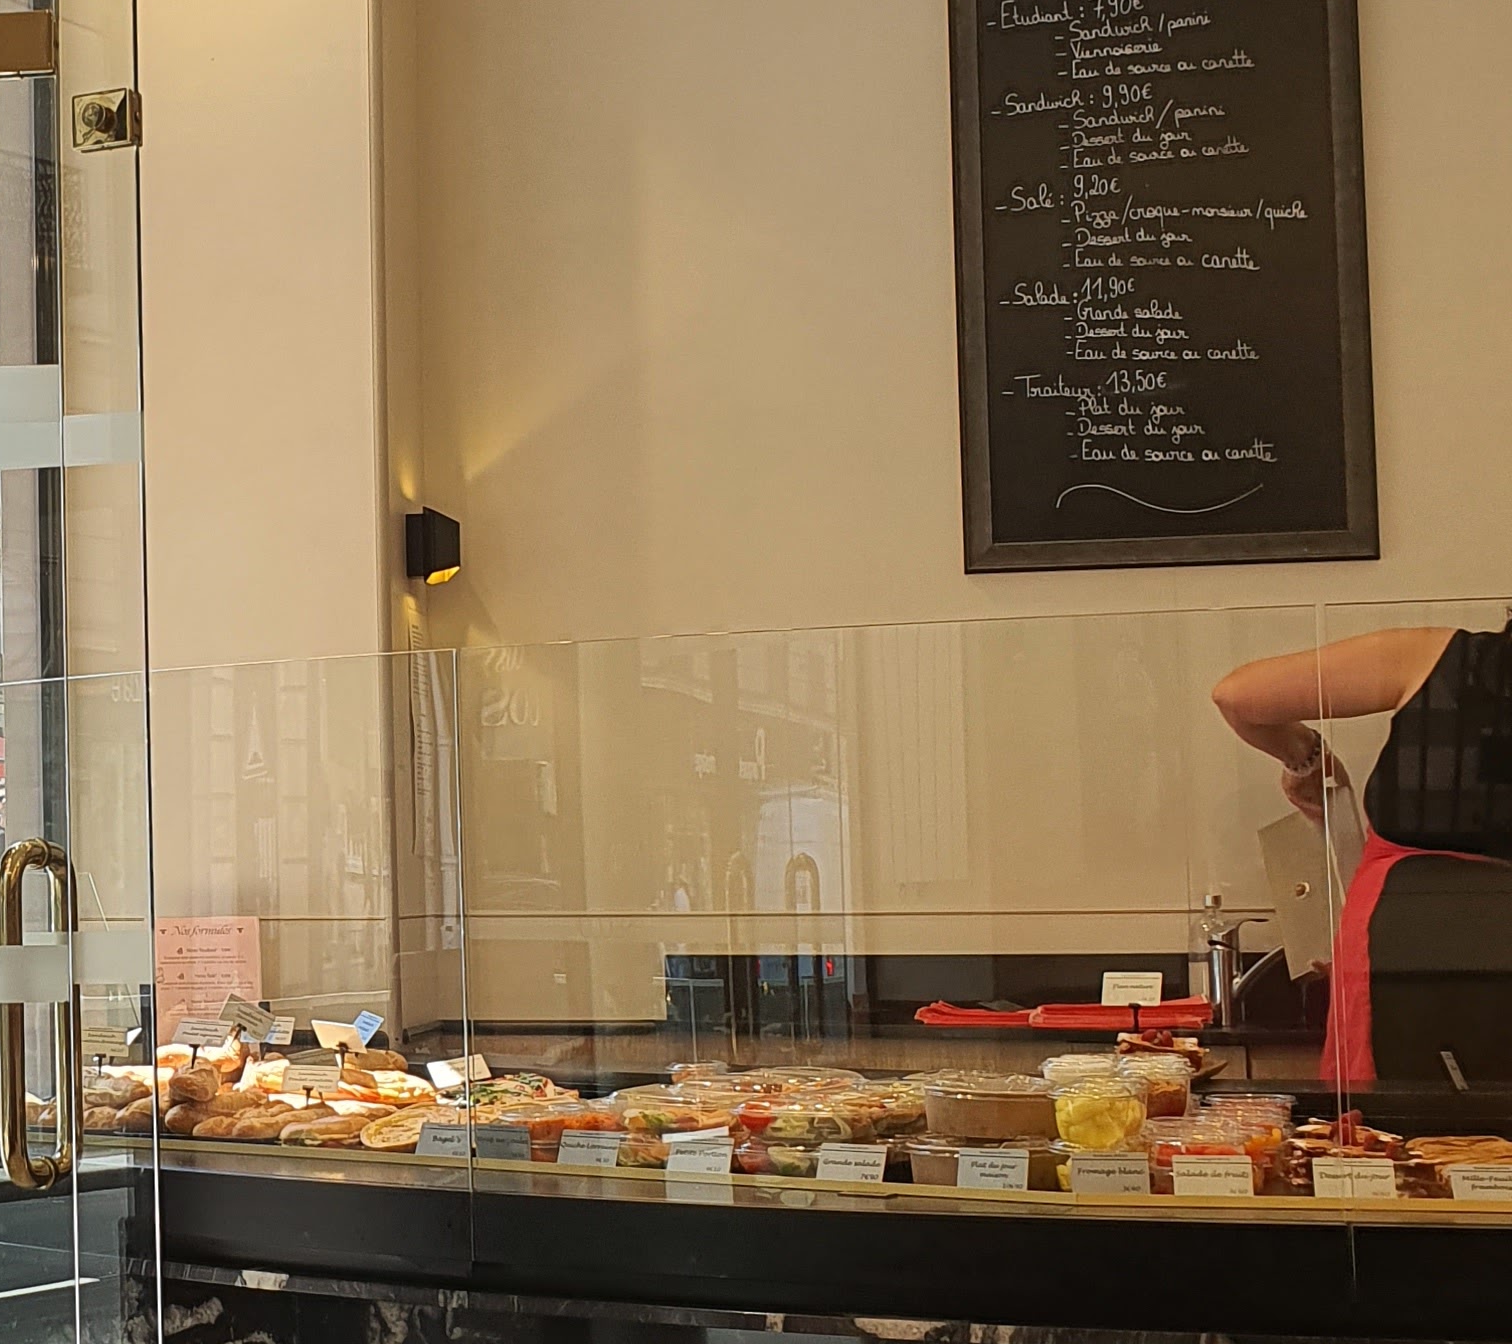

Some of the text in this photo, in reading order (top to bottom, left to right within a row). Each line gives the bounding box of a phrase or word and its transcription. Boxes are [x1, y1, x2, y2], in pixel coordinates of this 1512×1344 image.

[1070, 39, 1162, 58] Viennoiserie
[1072, 49, 1255, 79] Eau de source ou canette
[1102, 83, 1153, 108] 9,90€
[1072, 128, 1191, 150] Dessert du jour
[1073, 135, 1249, 169] Eau de source ou canette
[1073, 174, 1121, 200] 9,20€
[1075, 227, 1192, 248] Dessert du jour
[1075, 246, 1260, 271] Eau de source ou canette
[1080, 276, 1135, 303] 11,90€
[1076, 299, 1183, 321] Grande salade
[1075, 322, 1190, 344] Dessert du jour
[1075, 339, 1260, 360] Eau de source ou canette
[1105, 369, 1168, 394] 13,50€
[1079, 398, 1185, 423] Plat du jour
[1077, 417, 1205, 444] Dessert du jour
[1081, 438, 1278, 463] Eau de source ou canette
